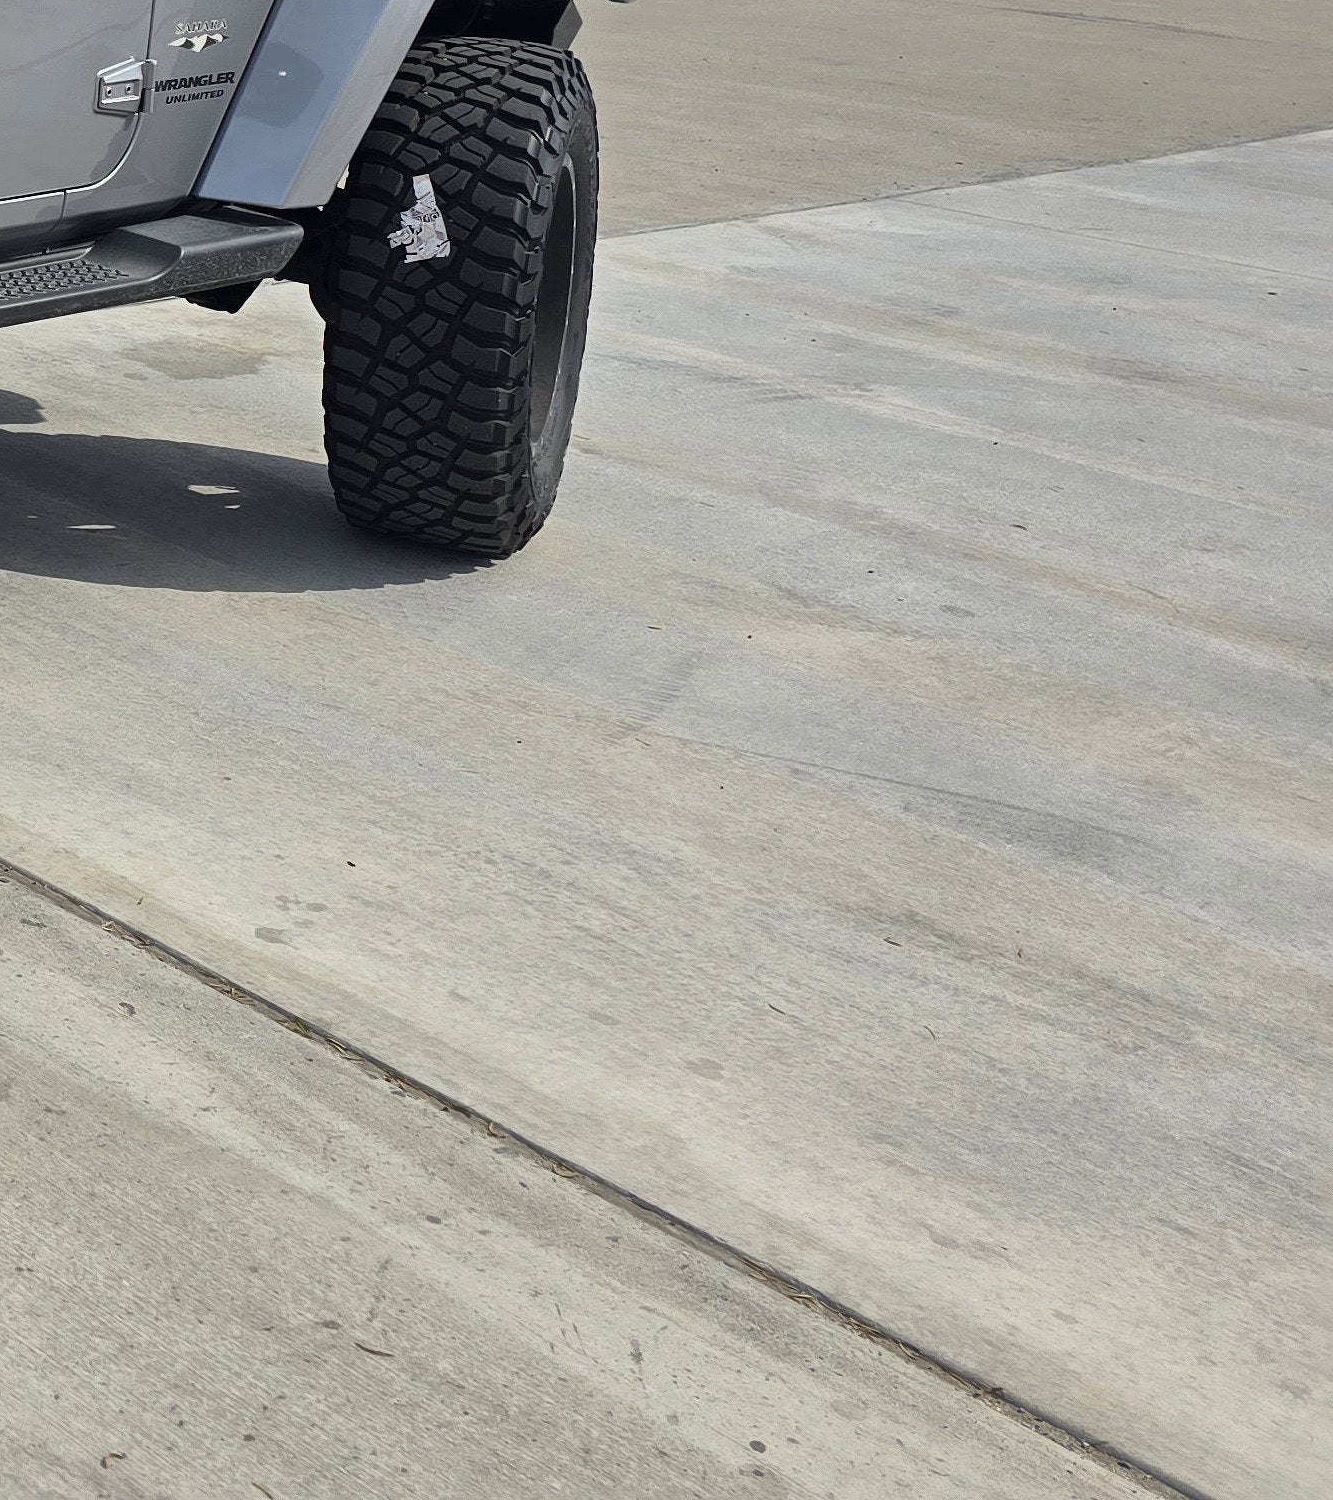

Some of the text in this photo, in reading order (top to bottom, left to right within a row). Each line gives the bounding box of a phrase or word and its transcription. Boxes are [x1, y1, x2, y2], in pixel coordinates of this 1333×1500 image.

[174, 18, 229, 35] SAHARA
[154, 71, 235, 92] WRANGLER
[165, 89, 224, 105] UNLIMITED
